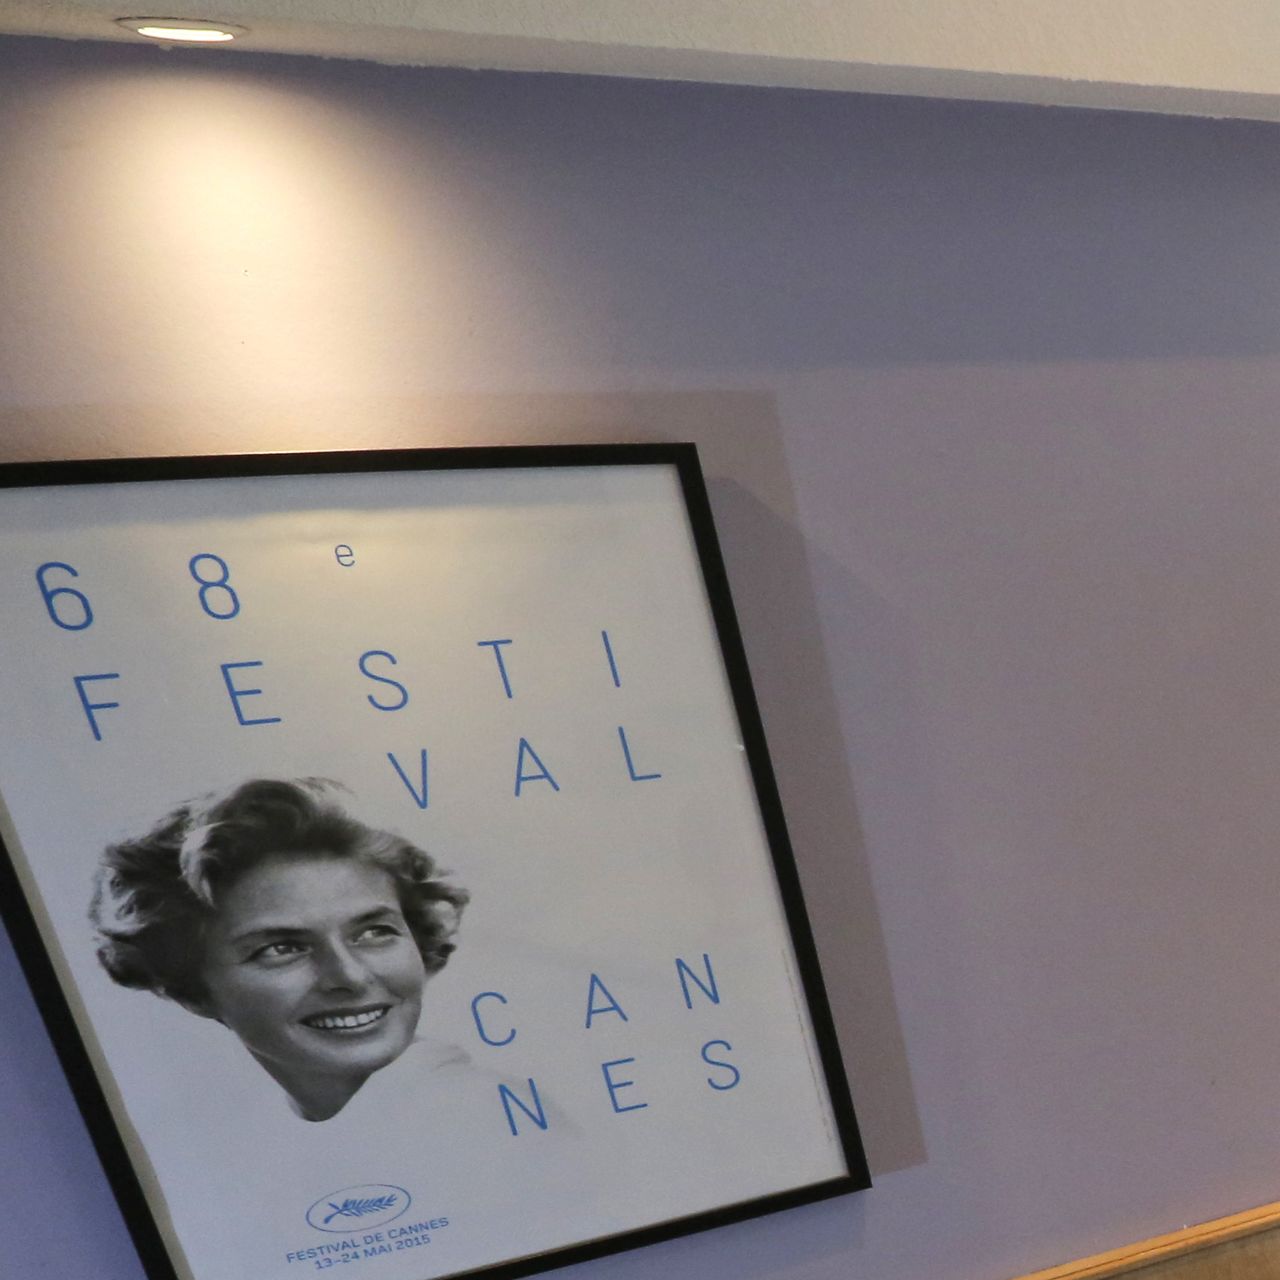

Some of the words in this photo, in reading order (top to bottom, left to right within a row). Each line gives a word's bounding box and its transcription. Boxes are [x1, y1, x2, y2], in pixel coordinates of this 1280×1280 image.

[73, 630, 623, 742] FESTI
[388, 726, 662, 810] VAL
[471, 952, 721, 1047] CAN
[499, 1039, 742, 1137] NES
[286, 1238, 361, 1264] FESTIVAL
[363, 1231, 384, 1246] DE
[387, 1217, 450, 1240] CANNES
[364, 1243, 392, 1258] MAI
[396, 1233, 432, 1250] 2015
